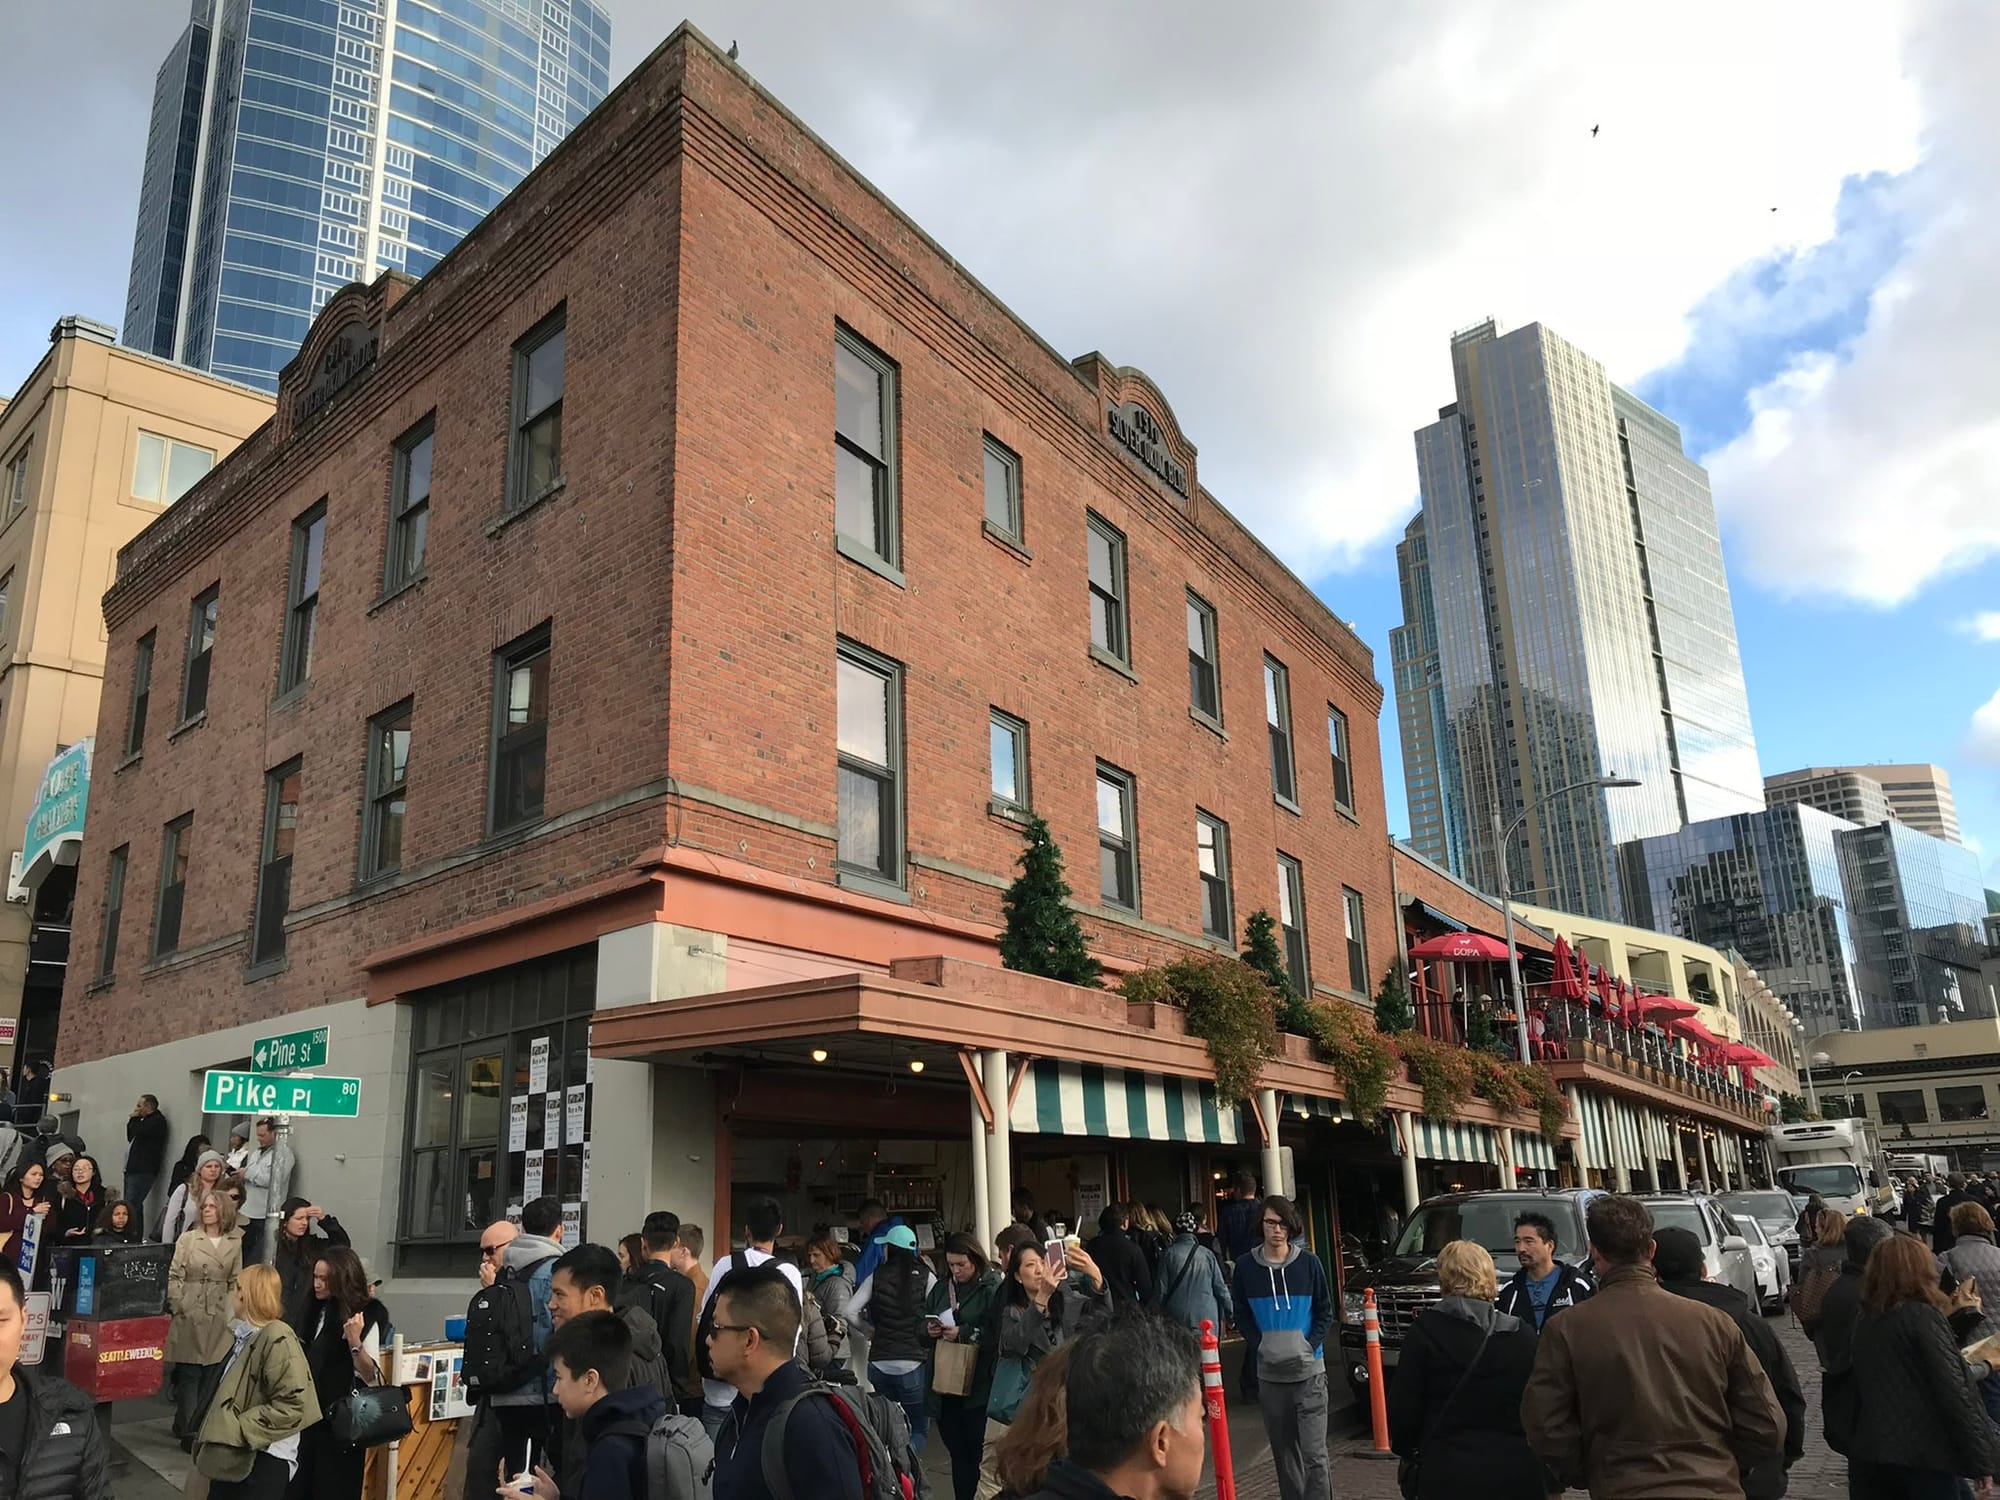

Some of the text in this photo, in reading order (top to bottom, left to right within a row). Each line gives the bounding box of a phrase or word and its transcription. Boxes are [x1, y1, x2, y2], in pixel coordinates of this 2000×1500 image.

[312, 1030, 327, 1045] 1500
[268, 1039, 311, 1068] Pine St
[215, 1076, 311, 1108] Pike Pl
[342, 1082, 357, 1095] 80
